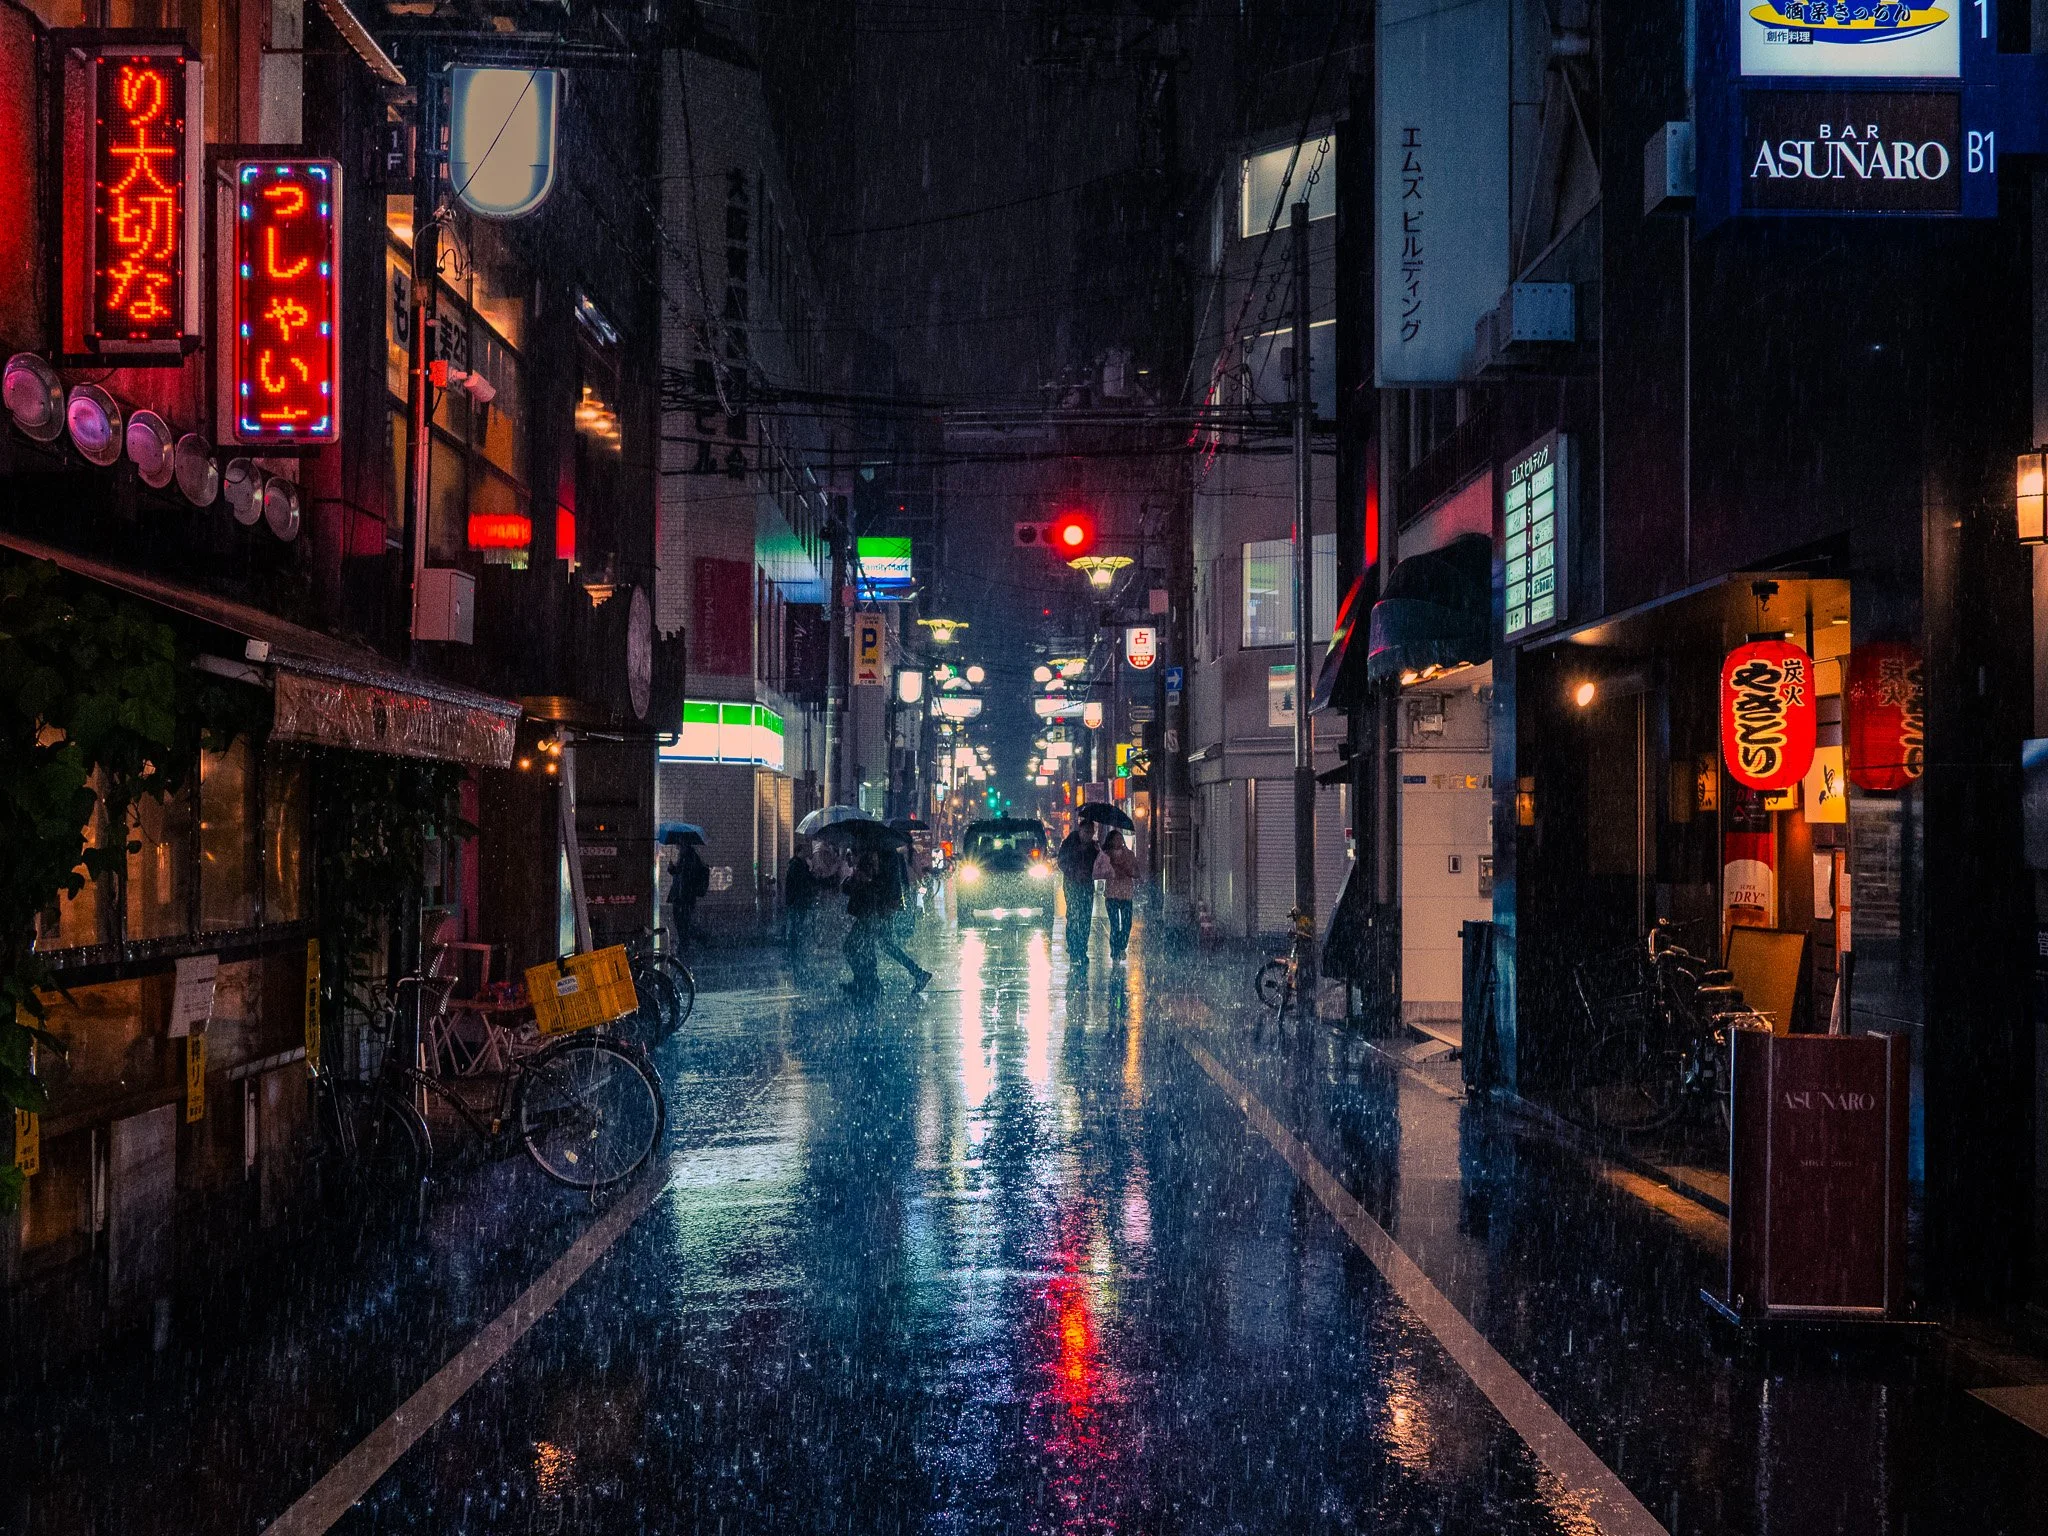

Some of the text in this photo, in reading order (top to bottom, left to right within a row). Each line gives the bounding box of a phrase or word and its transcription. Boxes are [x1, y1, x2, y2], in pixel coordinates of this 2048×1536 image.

[1766, 30, 1811, 43] 創作料理
[1819, 124, 1880, 139] BAR
[1967, 130, 1995, 174] B1
[1750, 140, 1950, 180] ASUNARO
[109, 65, 175, 319] り大切な
[1401, 127, 1424, 343] エムズ ビルディング
[861, 627, 877, 657] P
[1782, 658, 1805, 706] 炭火
[1732, 662, 1784, 776] やきとり
[1782, 1090, 1876, 1111] ASUNARO
